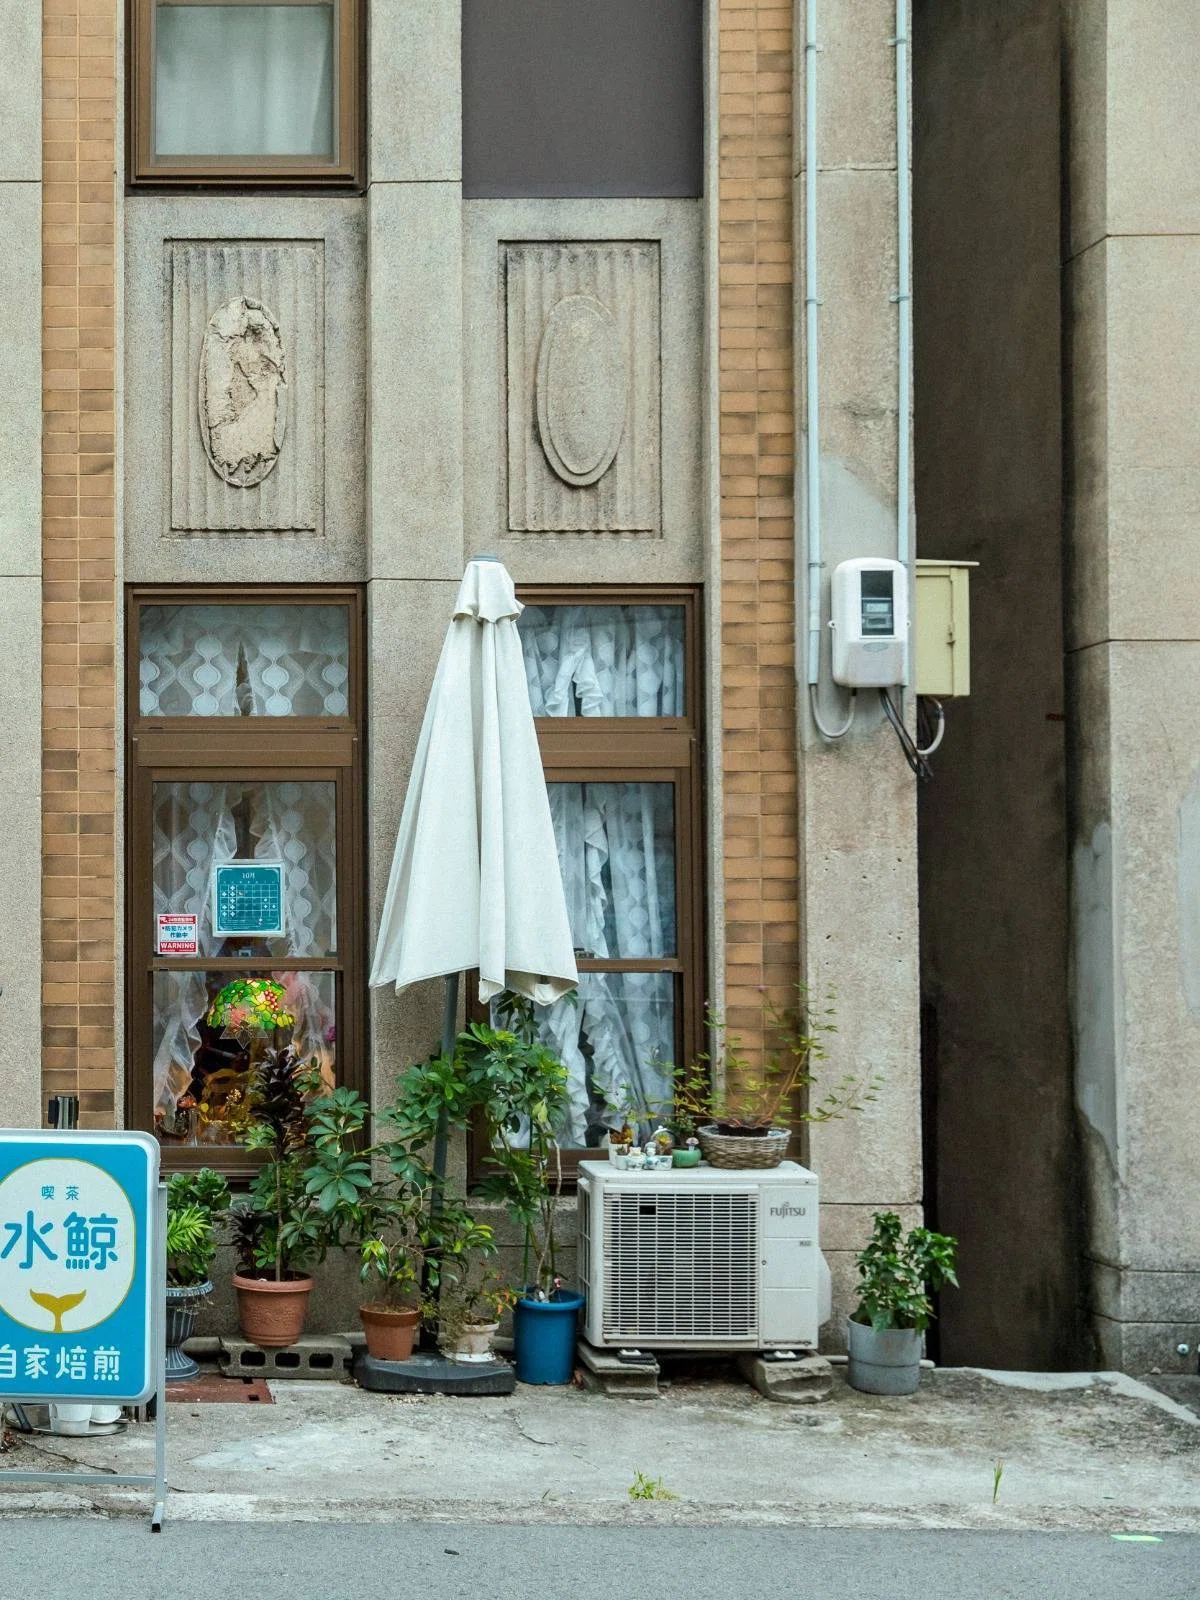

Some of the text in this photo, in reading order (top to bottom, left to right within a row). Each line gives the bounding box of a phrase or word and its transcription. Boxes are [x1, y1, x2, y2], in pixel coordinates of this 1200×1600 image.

[41, 1185, 80, 1201] 喫茶
[770, 1204, 806, 1219] FUJITSU
[0, 1210, 119, 1271] 水鯨
